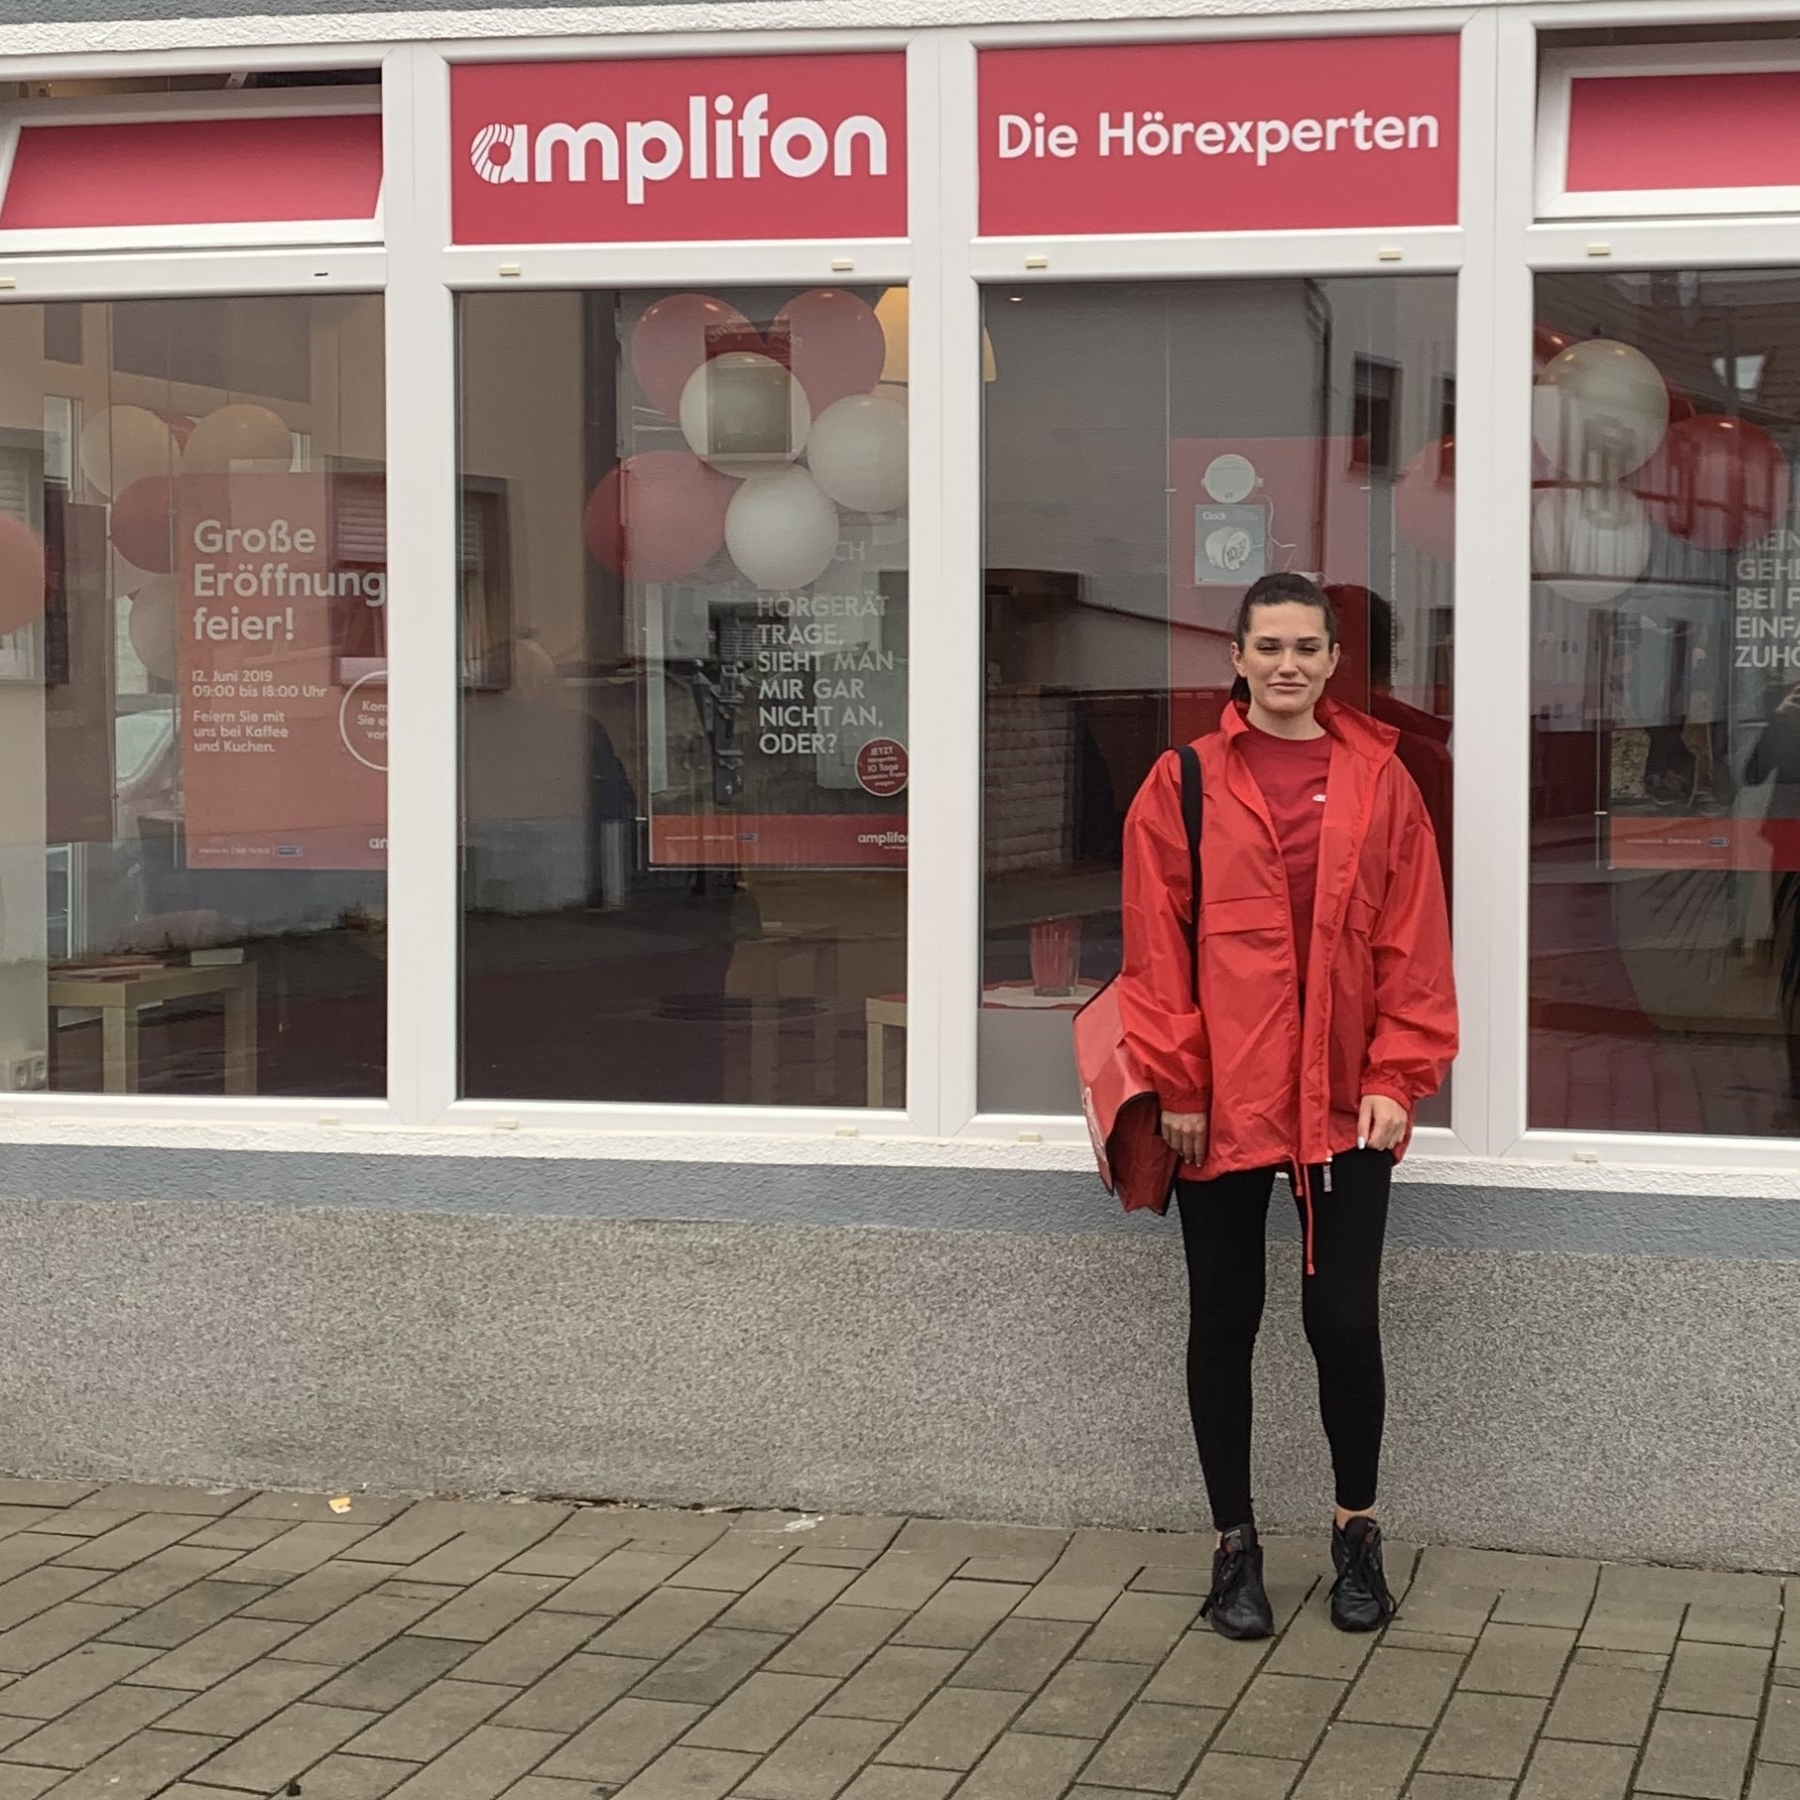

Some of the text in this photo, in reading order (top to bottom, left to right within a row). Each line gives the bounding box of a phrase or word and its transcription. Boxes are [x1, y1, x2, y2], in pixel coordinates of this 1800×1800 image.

[470, 93, 888, 205] amplifon
[998, 109, 1440, 167] Die Hörexperten
[193, 519, 317, 554] Große
[193, 563, 386, 608] Eröffnung
[756, 590, 889, 618] HÖRGERÄT
[1736, 587, 1776, 610] BEI
[192, 606, 296, 641] feier!
[758, 650, 893, 673] SIEHT MAN
[212, 669, 239, 682] Juni
[242, 669, 274, 682] 2019
[192, 684, 328, 698] 09:00 bis 18:00 Uhr
[758, 678, 866, 700] MIR GAR
[192, 710, 285, 723] Feiern Sie mit
[758, 705, 884, 728] NICHT AN,
[193, 725, 289, 738] uns bei Kaffee
[194, 741, 220, 753] und
[759, 733, 838, 755] ODER?
